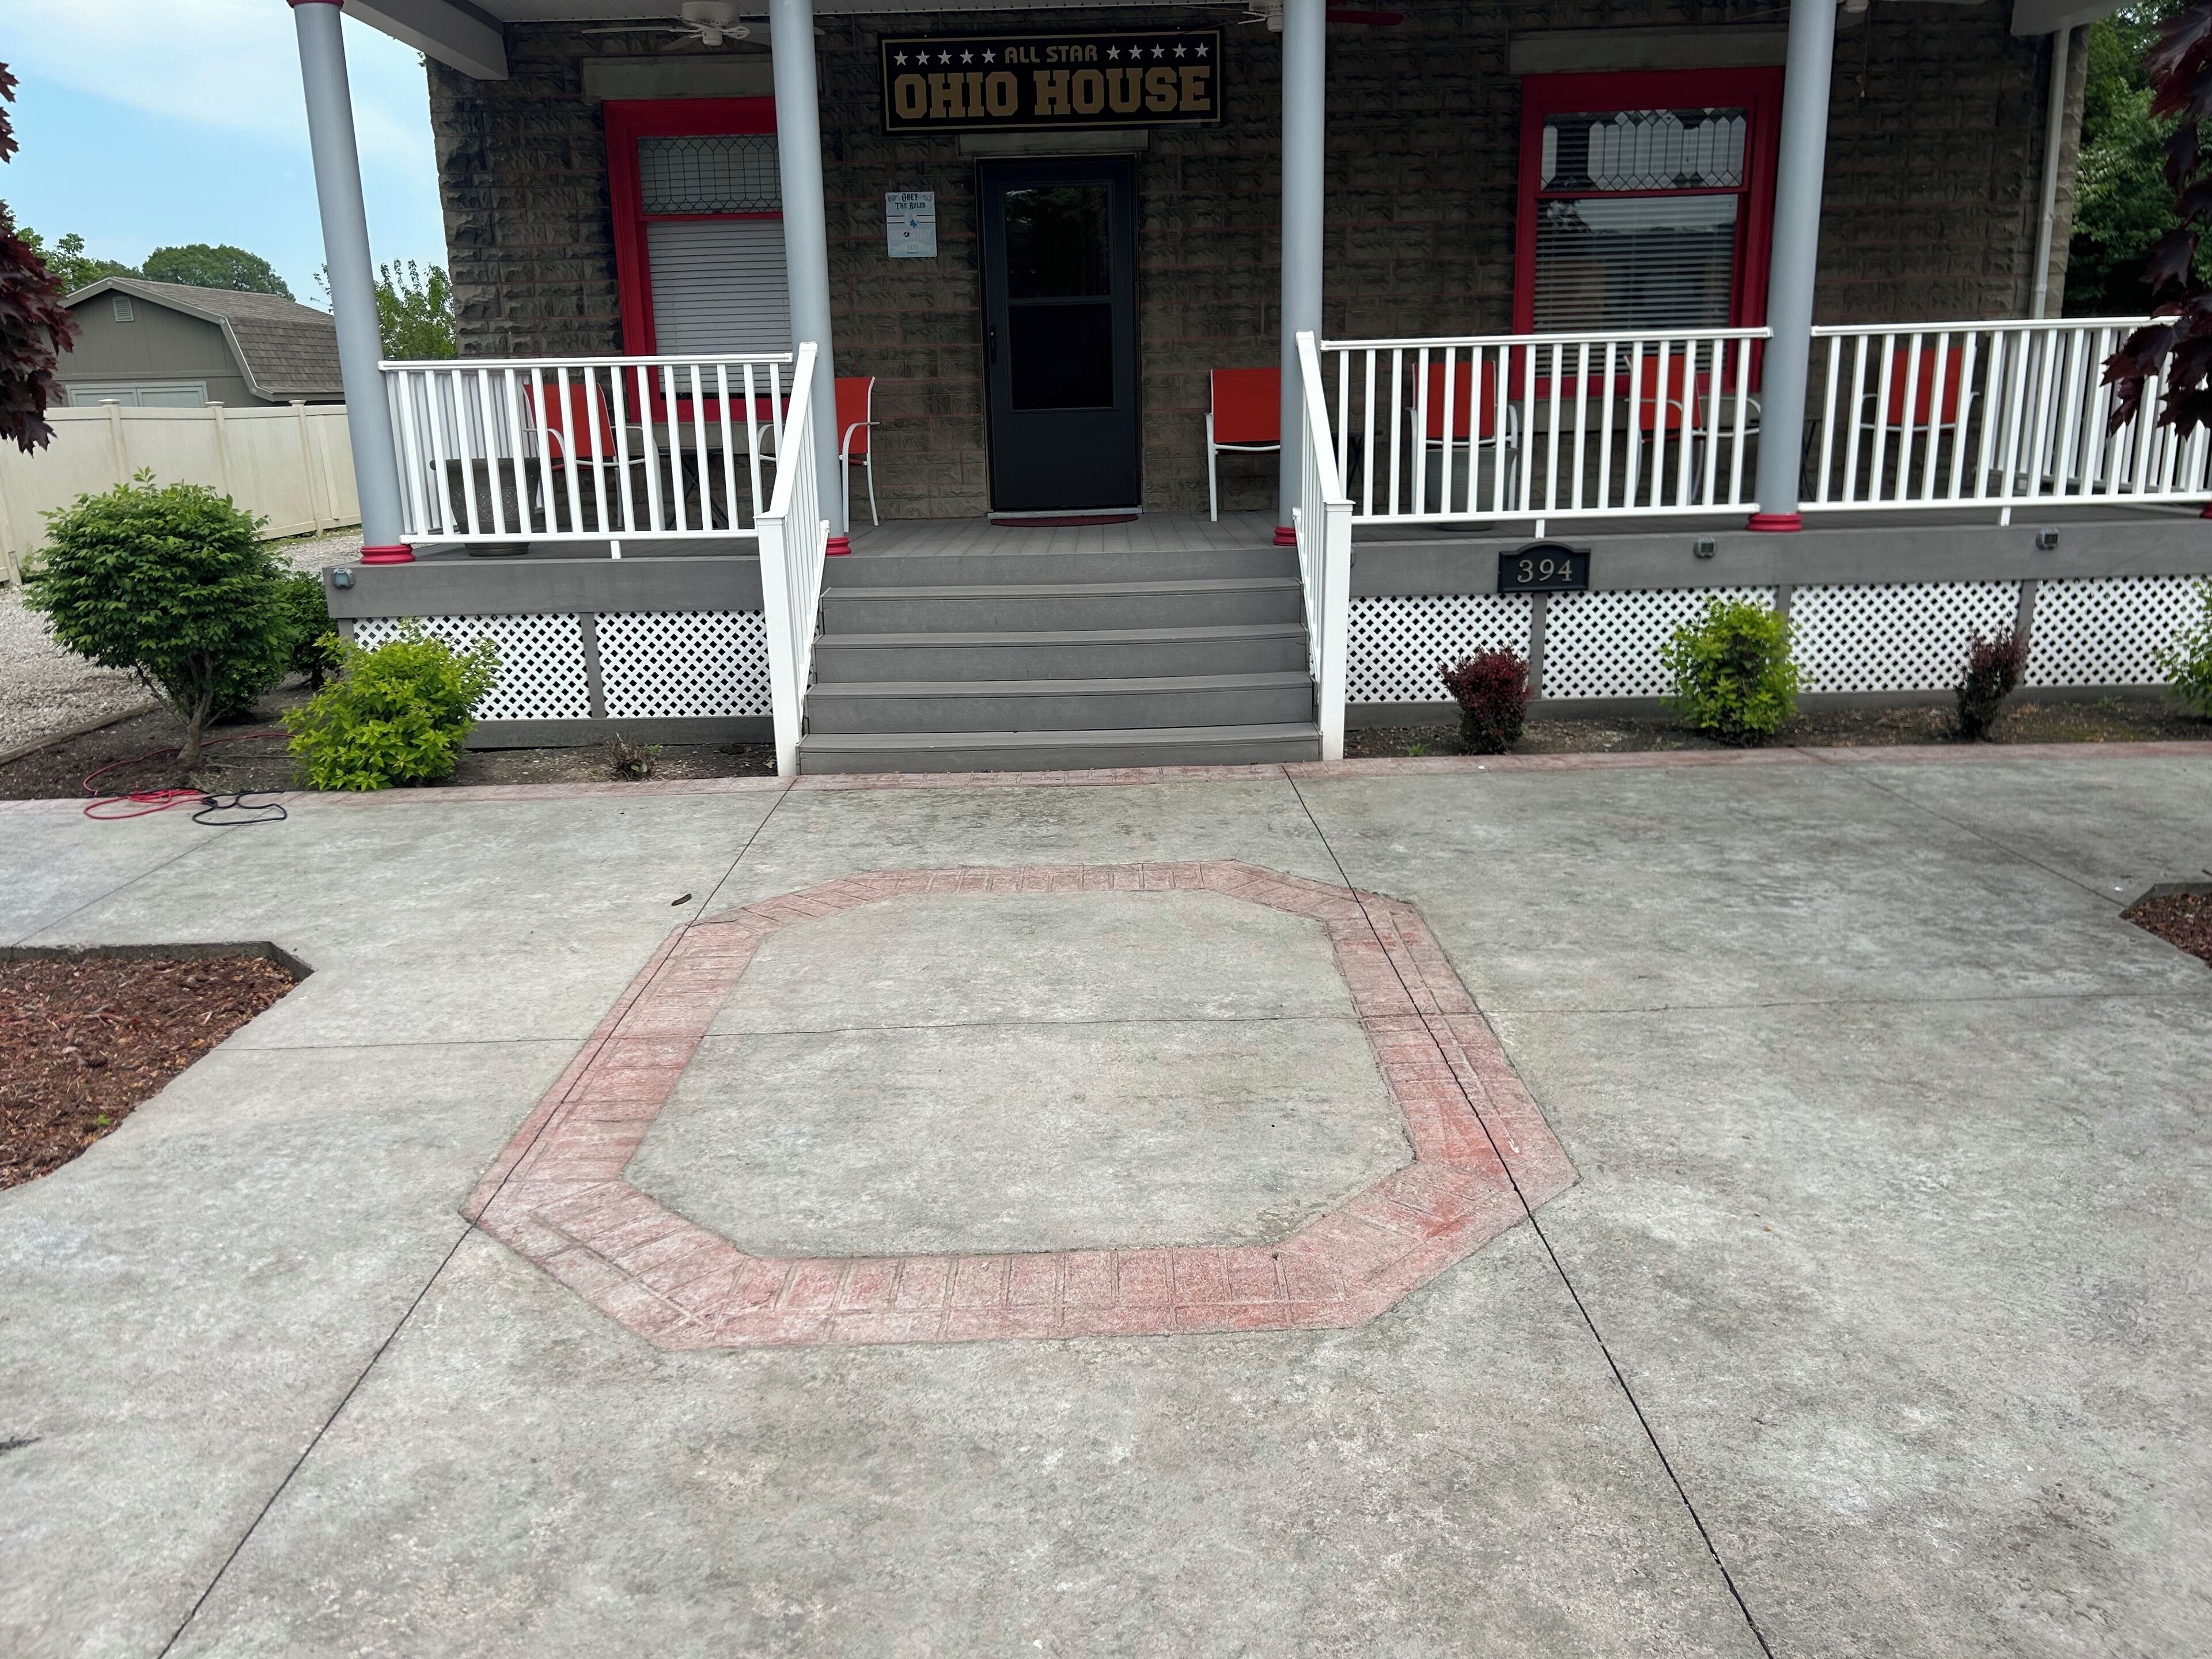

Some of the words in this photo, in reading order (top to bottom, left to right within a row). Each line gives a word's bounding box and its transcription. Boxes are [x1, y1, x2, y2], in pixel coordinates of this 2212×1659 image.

[1005, 47, 1040, 64] ALL
[1046, 44, 1097, 62] STAR
[894, 71, 1018, 119] OHIO
[1033, 66, 1210, 115] HOUSE
[902, 193, 918, 202] OBEY
[1517, 559, 1573, 583] 394
